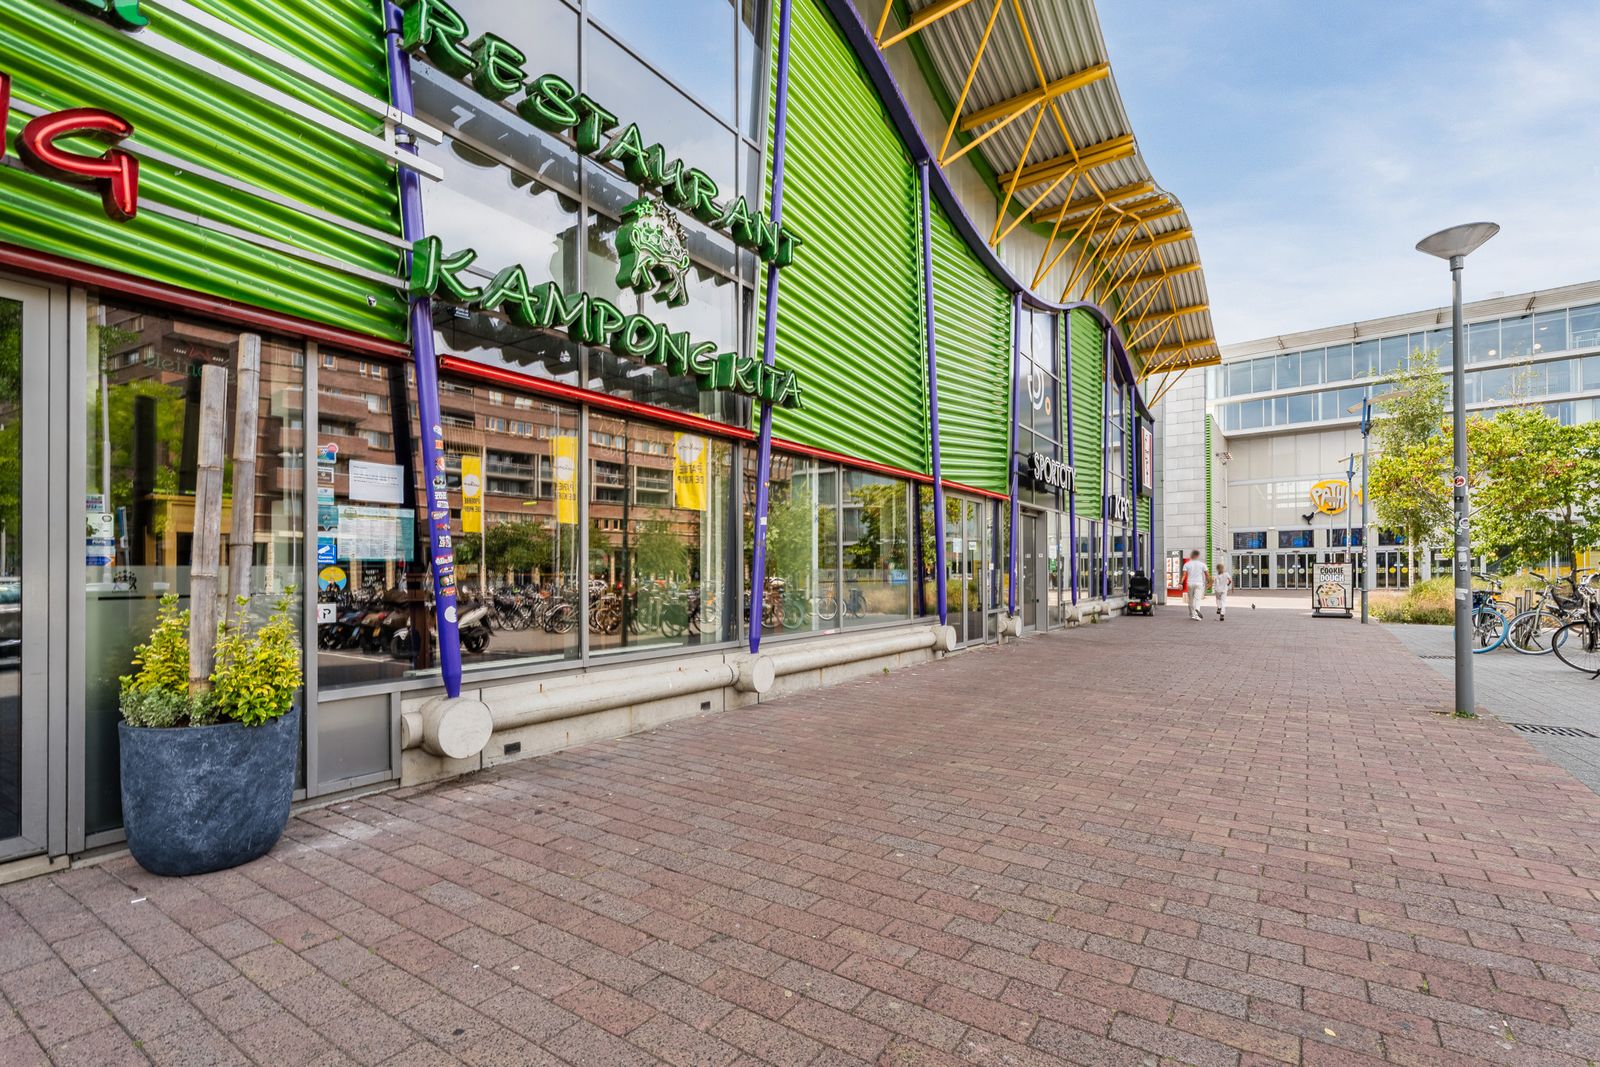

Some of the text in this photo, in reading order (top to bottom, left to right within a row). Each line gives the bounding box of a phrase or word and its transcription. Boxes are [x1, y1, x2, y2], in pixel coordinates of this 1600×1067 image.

[0, 71, 139, 223] G
[402, 0, 803, 269] RESTAURANT
[409, 235, 806, 410] KAMPONG KITA
[1115, 494, 1130, 523] KFC
[1312, 484, 1347, 509] PATH
[1320, 567, 1344, 575] COOKIE
[1320, 574, 1345, 582] DOUGH
